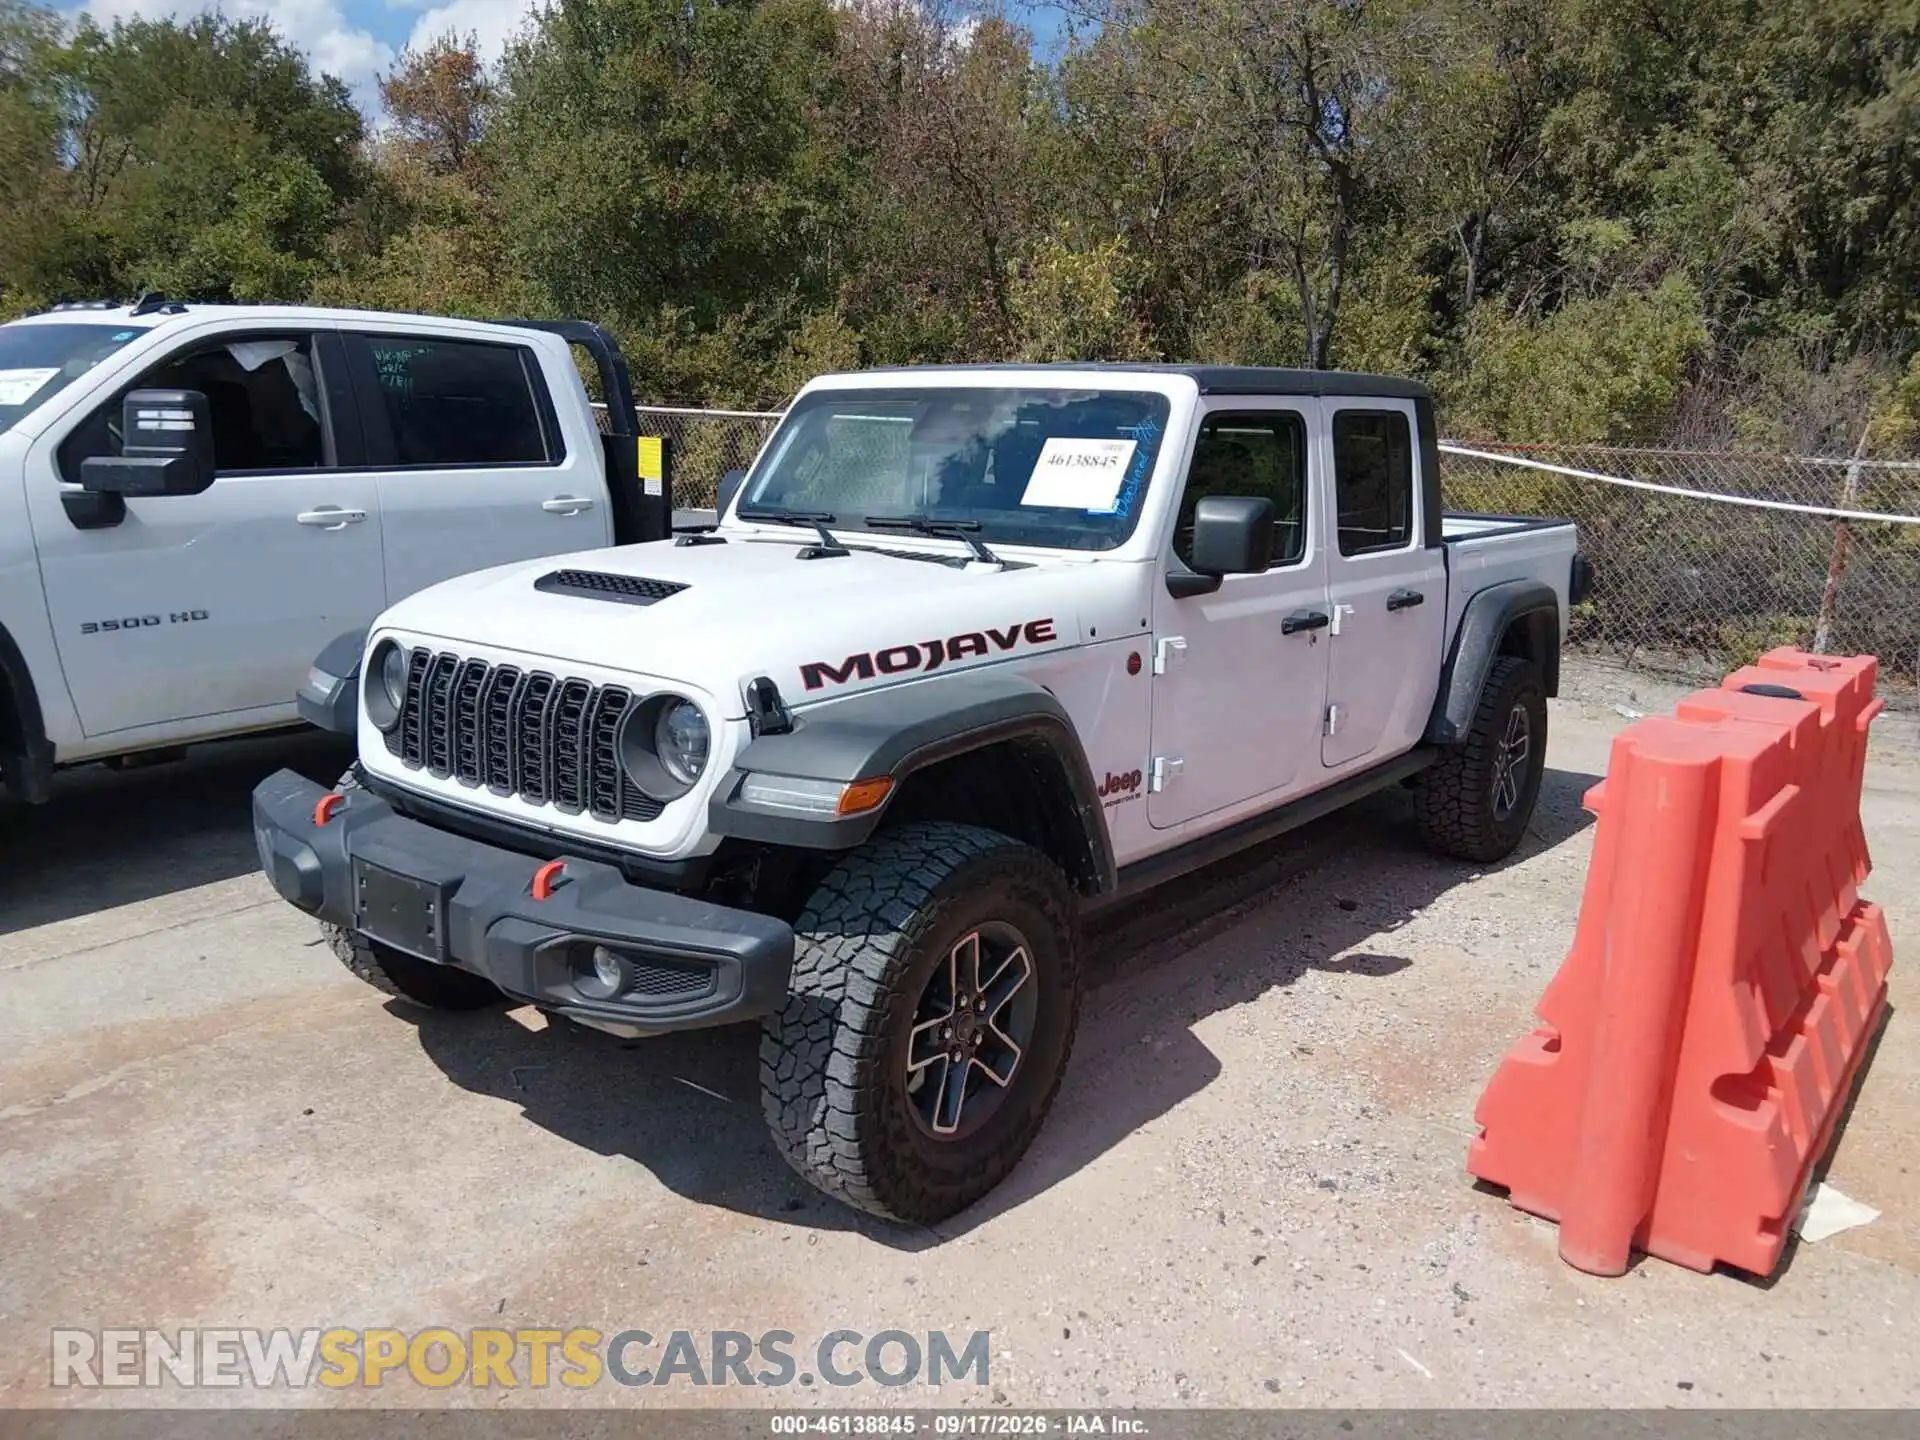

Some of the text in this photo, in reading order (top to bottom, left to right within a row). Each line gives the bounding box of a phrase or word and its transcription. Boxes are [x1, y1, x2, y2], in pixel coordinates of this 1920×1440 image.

[1047, 453, 1119, 469] 46138845
[80, 610, 209, 634] 3500 HD
[799, 618, 1057, 690] MOJAVE
[1098, 769, 1142, 797] Jeep
